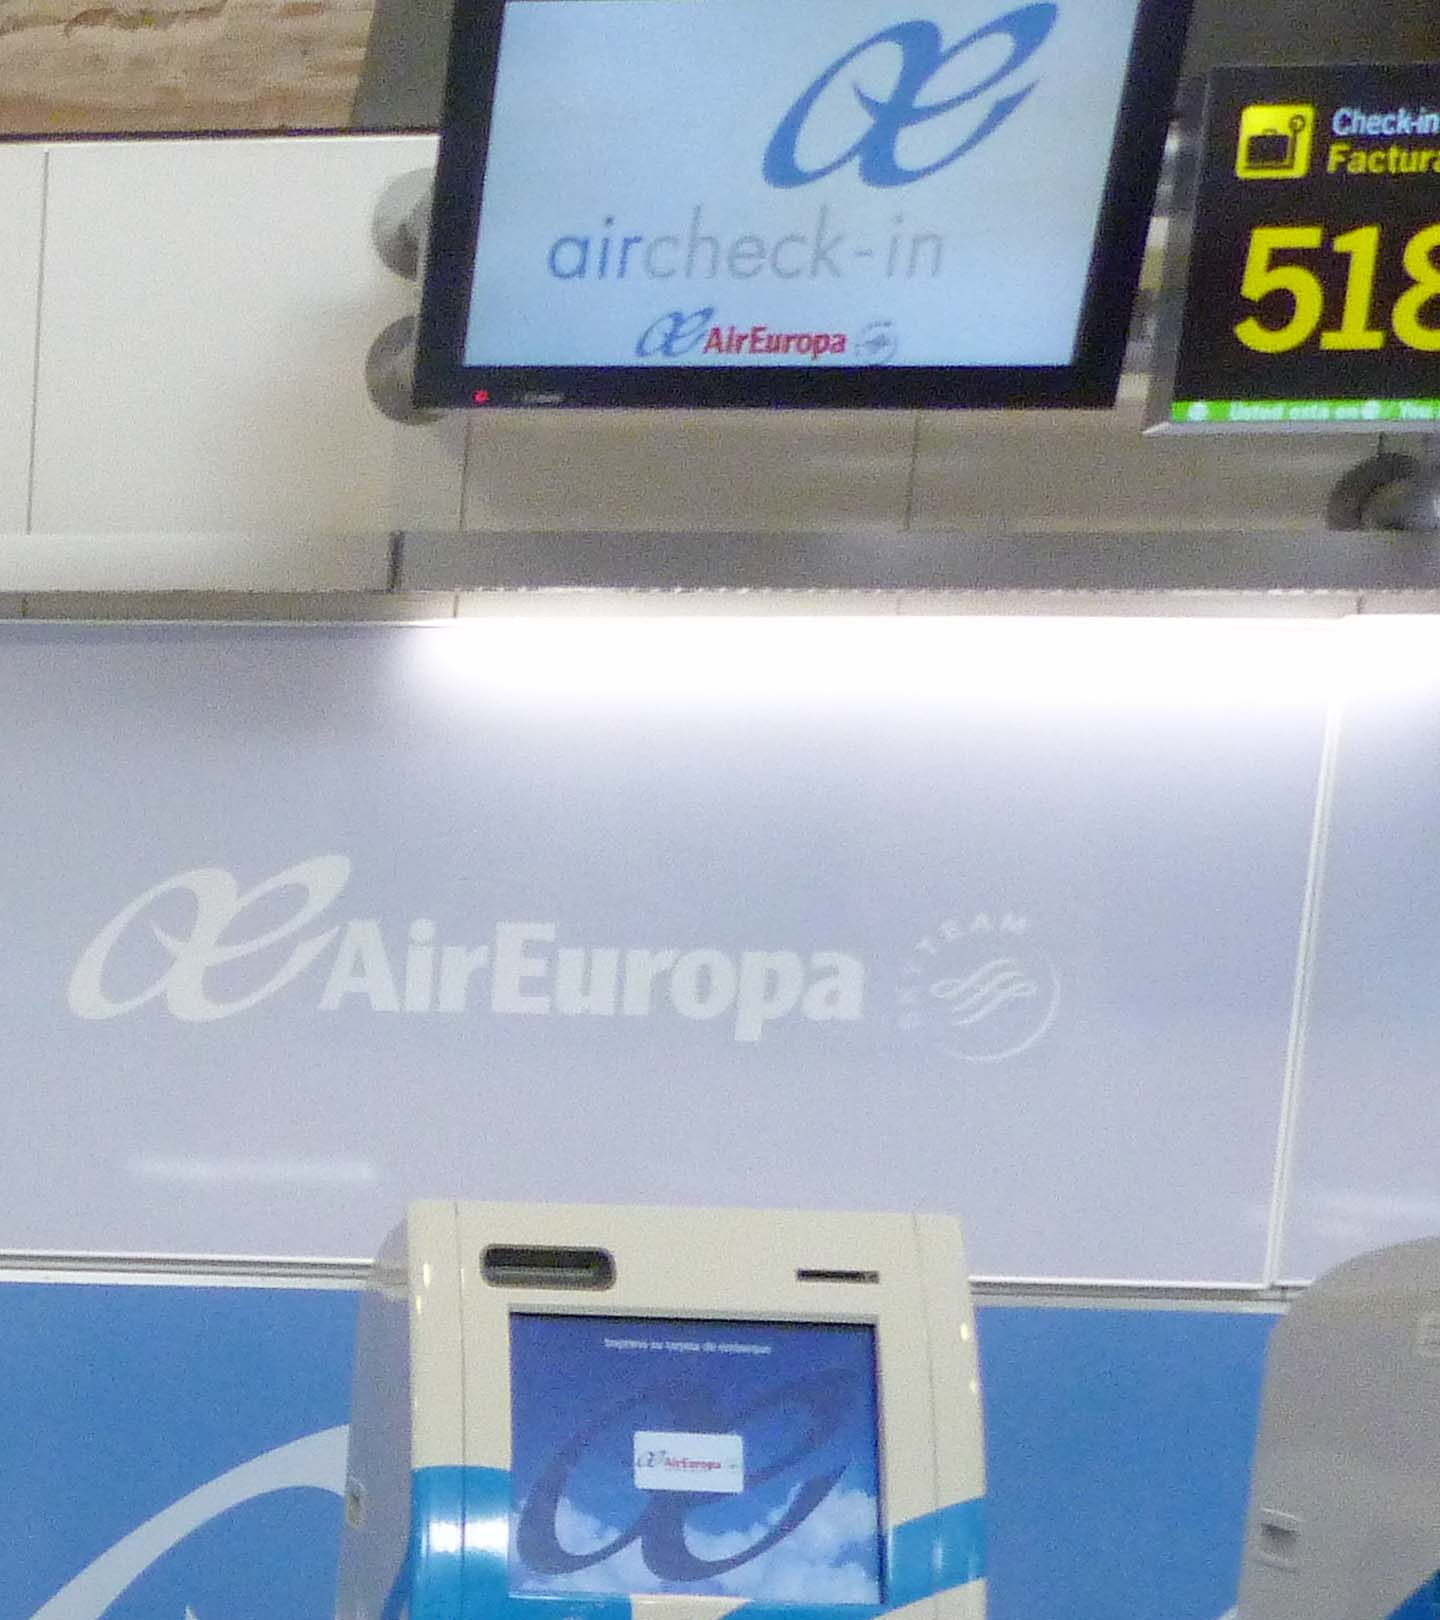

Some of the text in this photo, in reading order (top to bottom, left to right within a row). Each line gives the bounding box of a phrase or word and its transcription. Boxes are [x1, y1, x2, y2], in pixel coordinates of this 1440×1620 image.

[548, 205, 942, 280] aircheck-in
[703, 327, 846, 359] AirEuropa
[320, 919, 864, 1042] AirEuropa
[665, 1456, 721, 1472] AirEuropa
